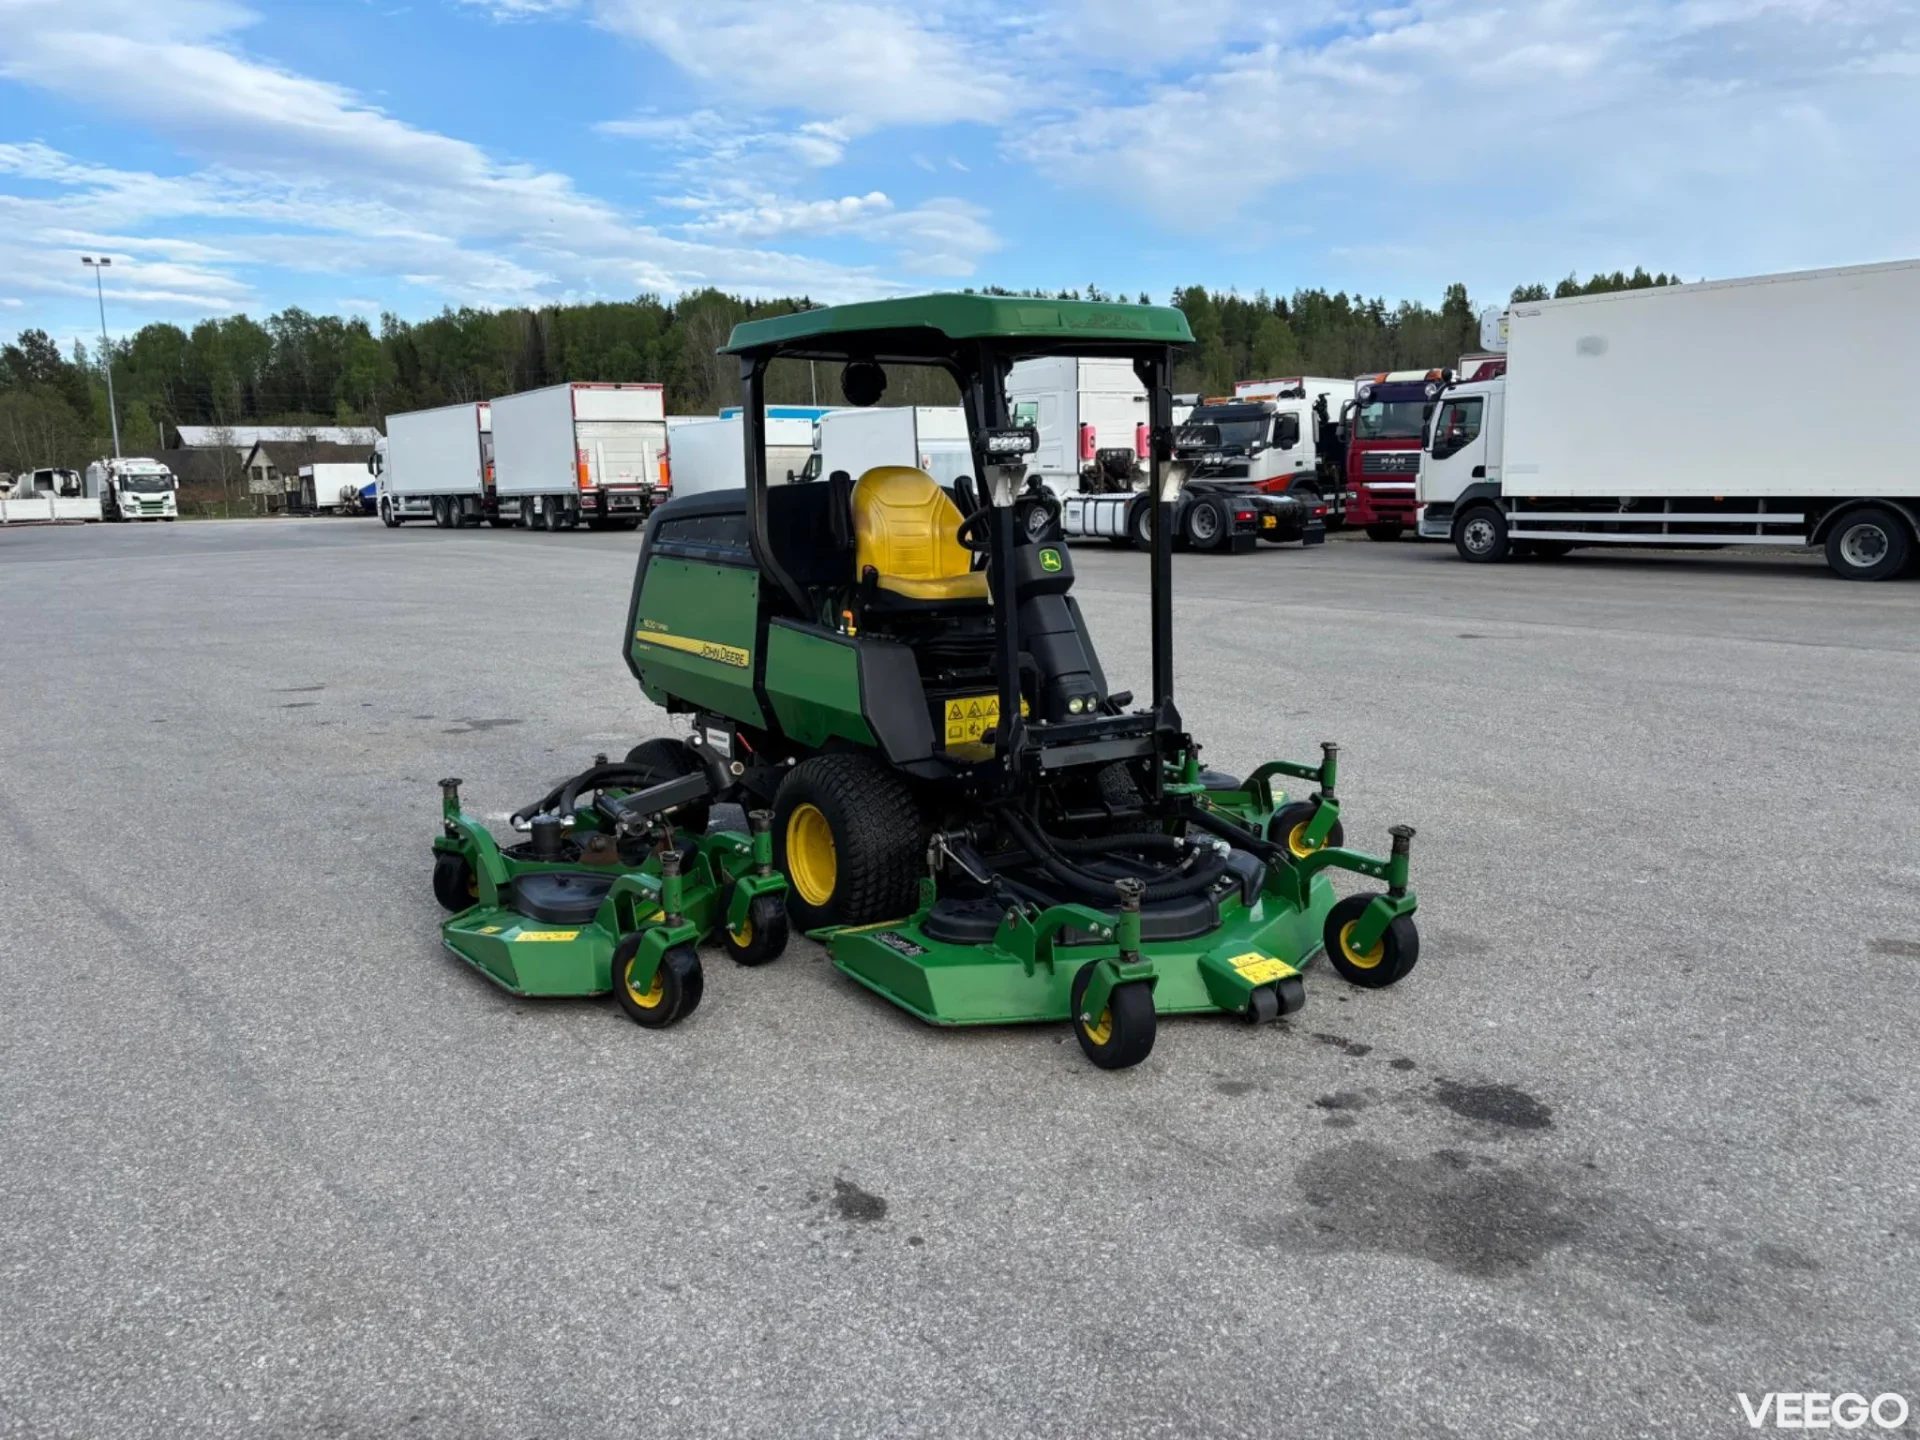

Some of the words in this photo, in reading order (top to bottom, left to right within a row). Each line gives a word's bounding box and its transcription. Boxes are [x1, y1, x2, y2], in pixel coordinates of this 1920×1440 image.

[1380, 457, 1406, 465] MAN
[700, 642, 720, 659] JOHN
[720, 646, 745, 665] DEERE
